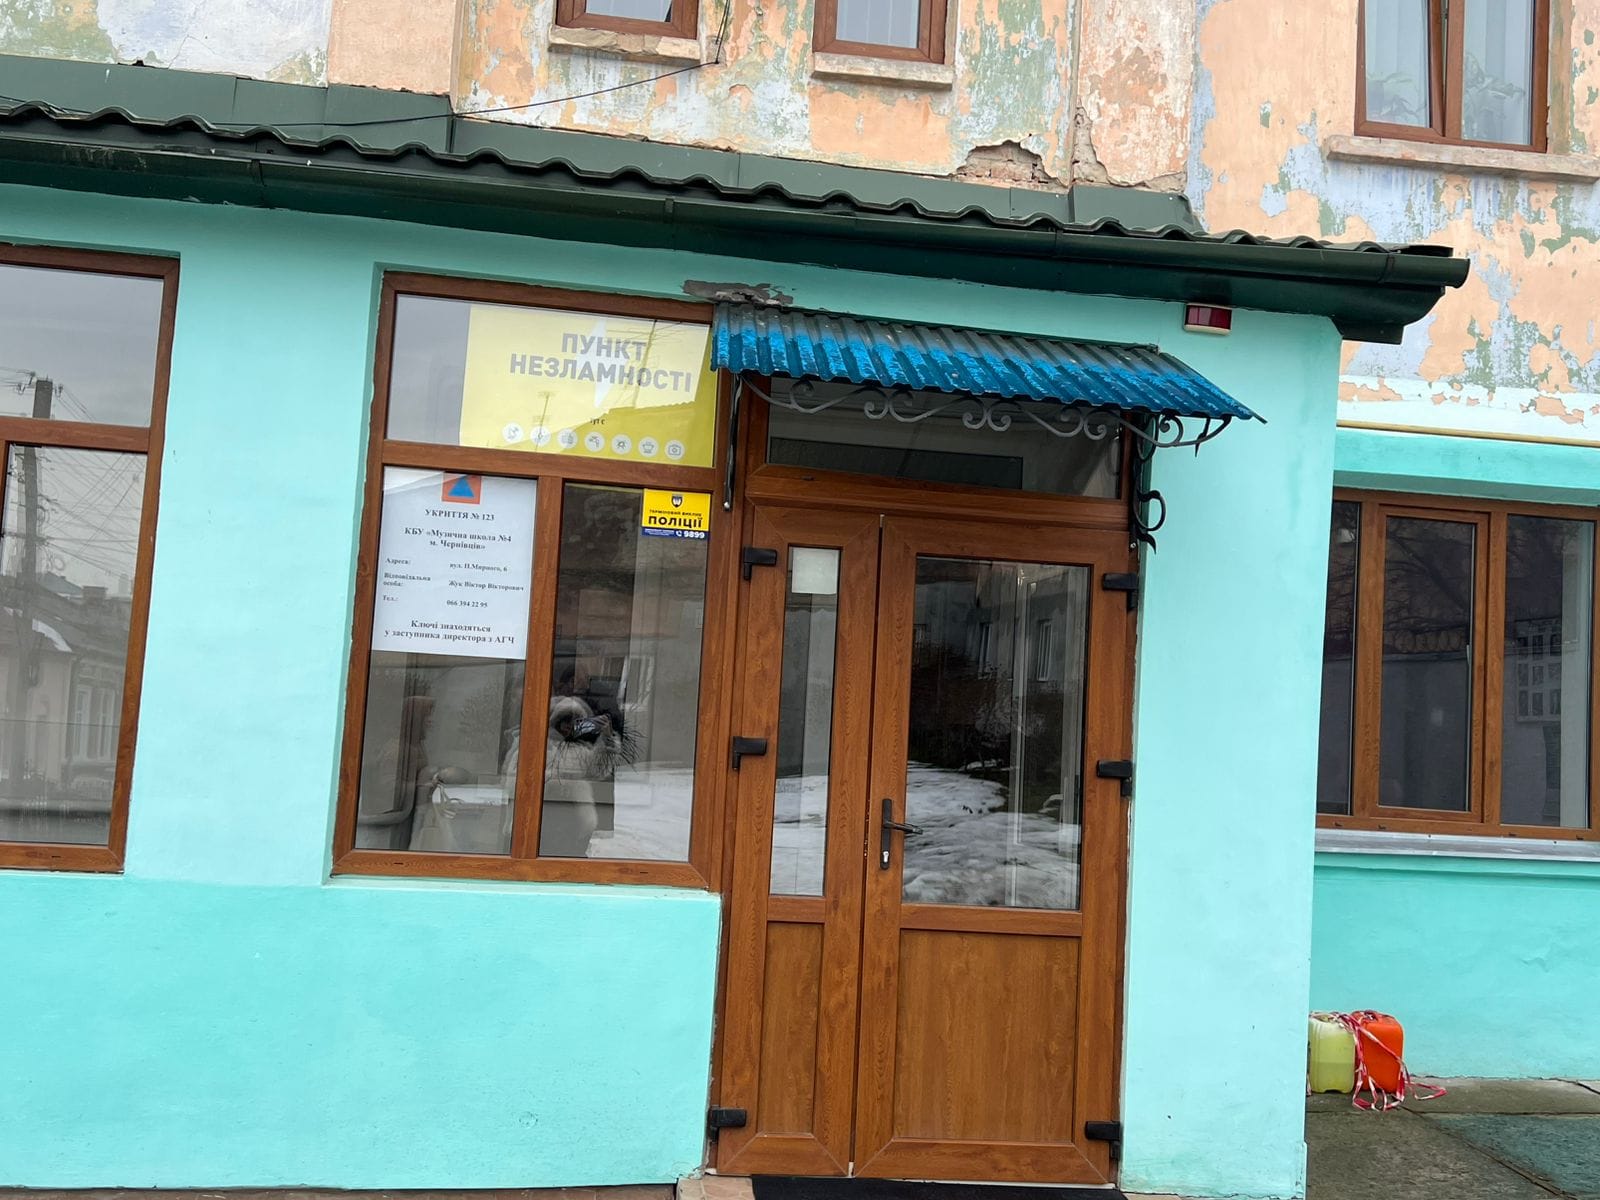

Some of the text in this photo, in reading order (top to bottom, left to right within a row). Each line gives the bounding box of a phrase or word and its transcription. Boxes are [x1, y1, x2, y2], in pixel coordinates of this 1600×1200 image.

[561, 332, 647, 361] ПУНКТ
[510, 353, 692, 392] НЕЗЛАМНОСТІ
[425, 508, 468, 519] УКРИТТЯ
[648, 516, 704, 528] ПОЛІЦІЇ
[404, 527, 511, 542] КБУ «Музична школа №4
[411, 620, 491, 632] Ключі знаходяться
[392, 631, 440, 641] заступника
[442, 633, 486, 643] директора
[494, 635, 515, 644] АГЧ
